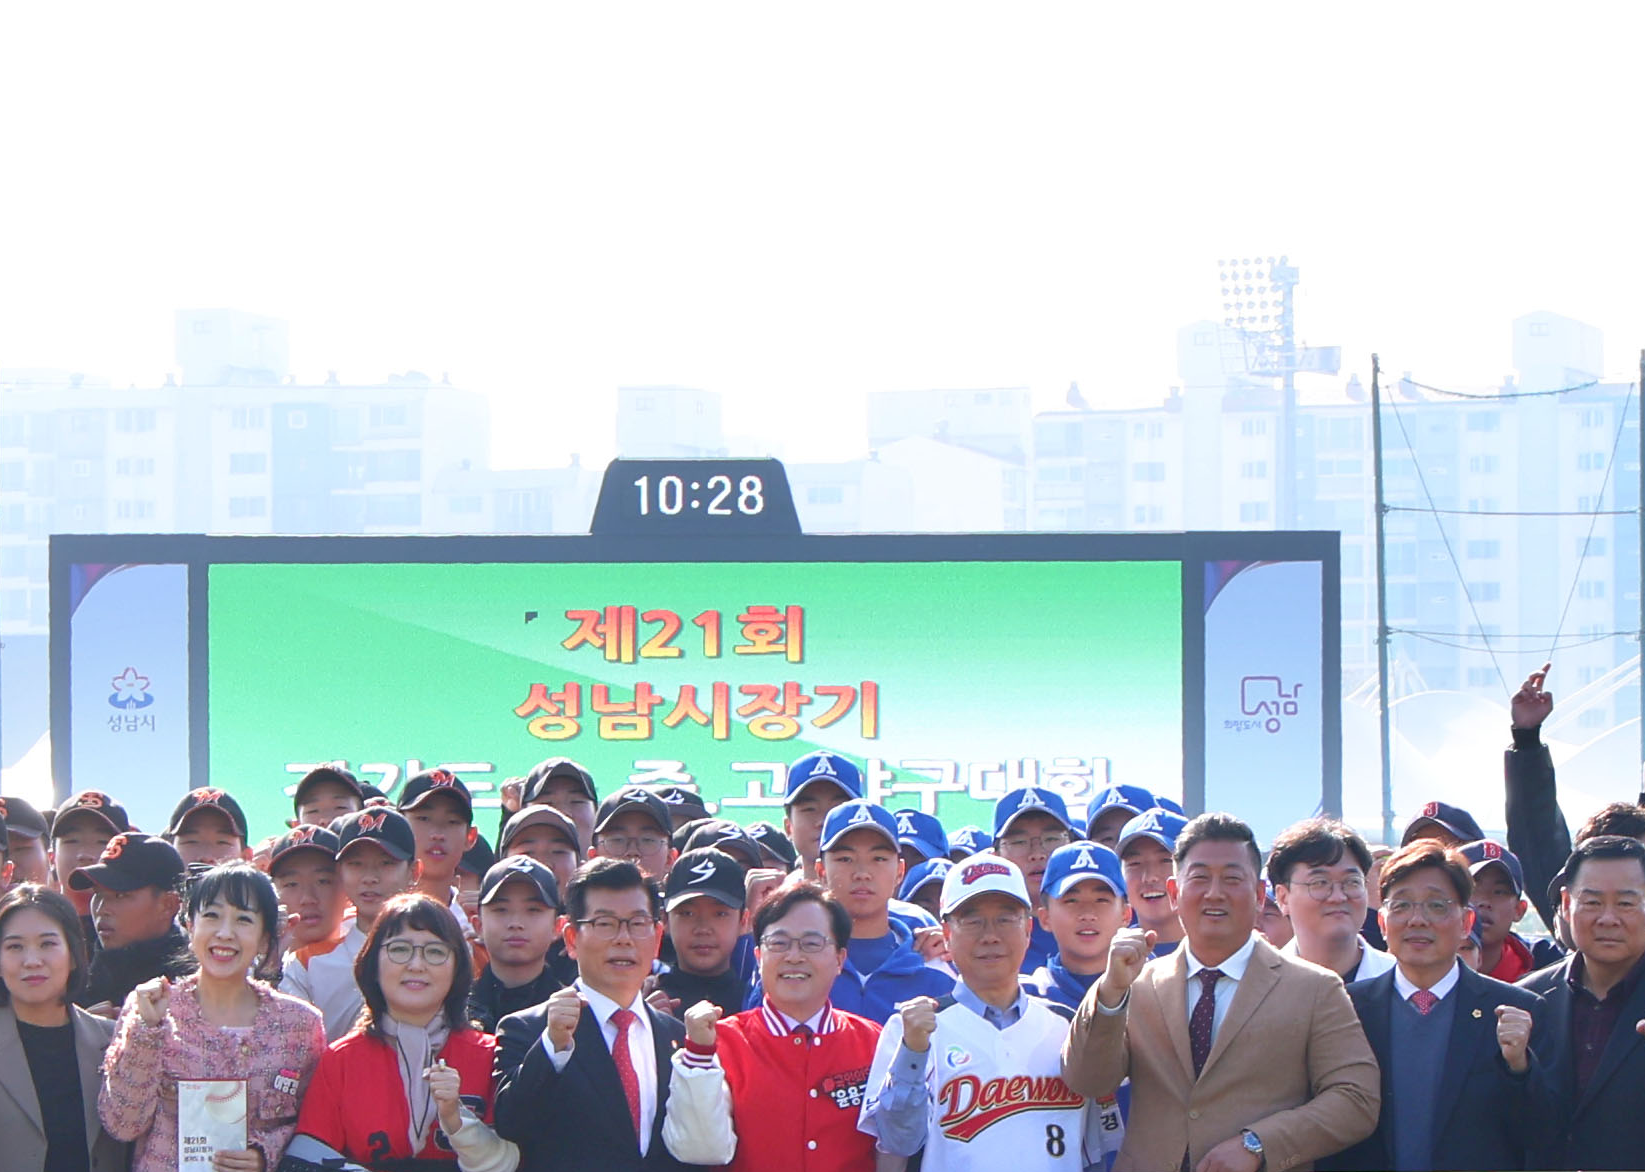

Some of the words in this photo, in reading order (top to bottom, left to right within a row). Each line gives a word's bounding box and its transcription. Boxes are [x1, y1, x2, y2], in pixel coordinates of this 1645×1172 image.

[633, 474, 765, 517] 10:28
[561, 604, 805, 666] 제21회
[107, 714, 155, 732] 성남시
[513, 680, 881, 741] 성남시장기
[1045, 1123, 1066, 1157] 8
